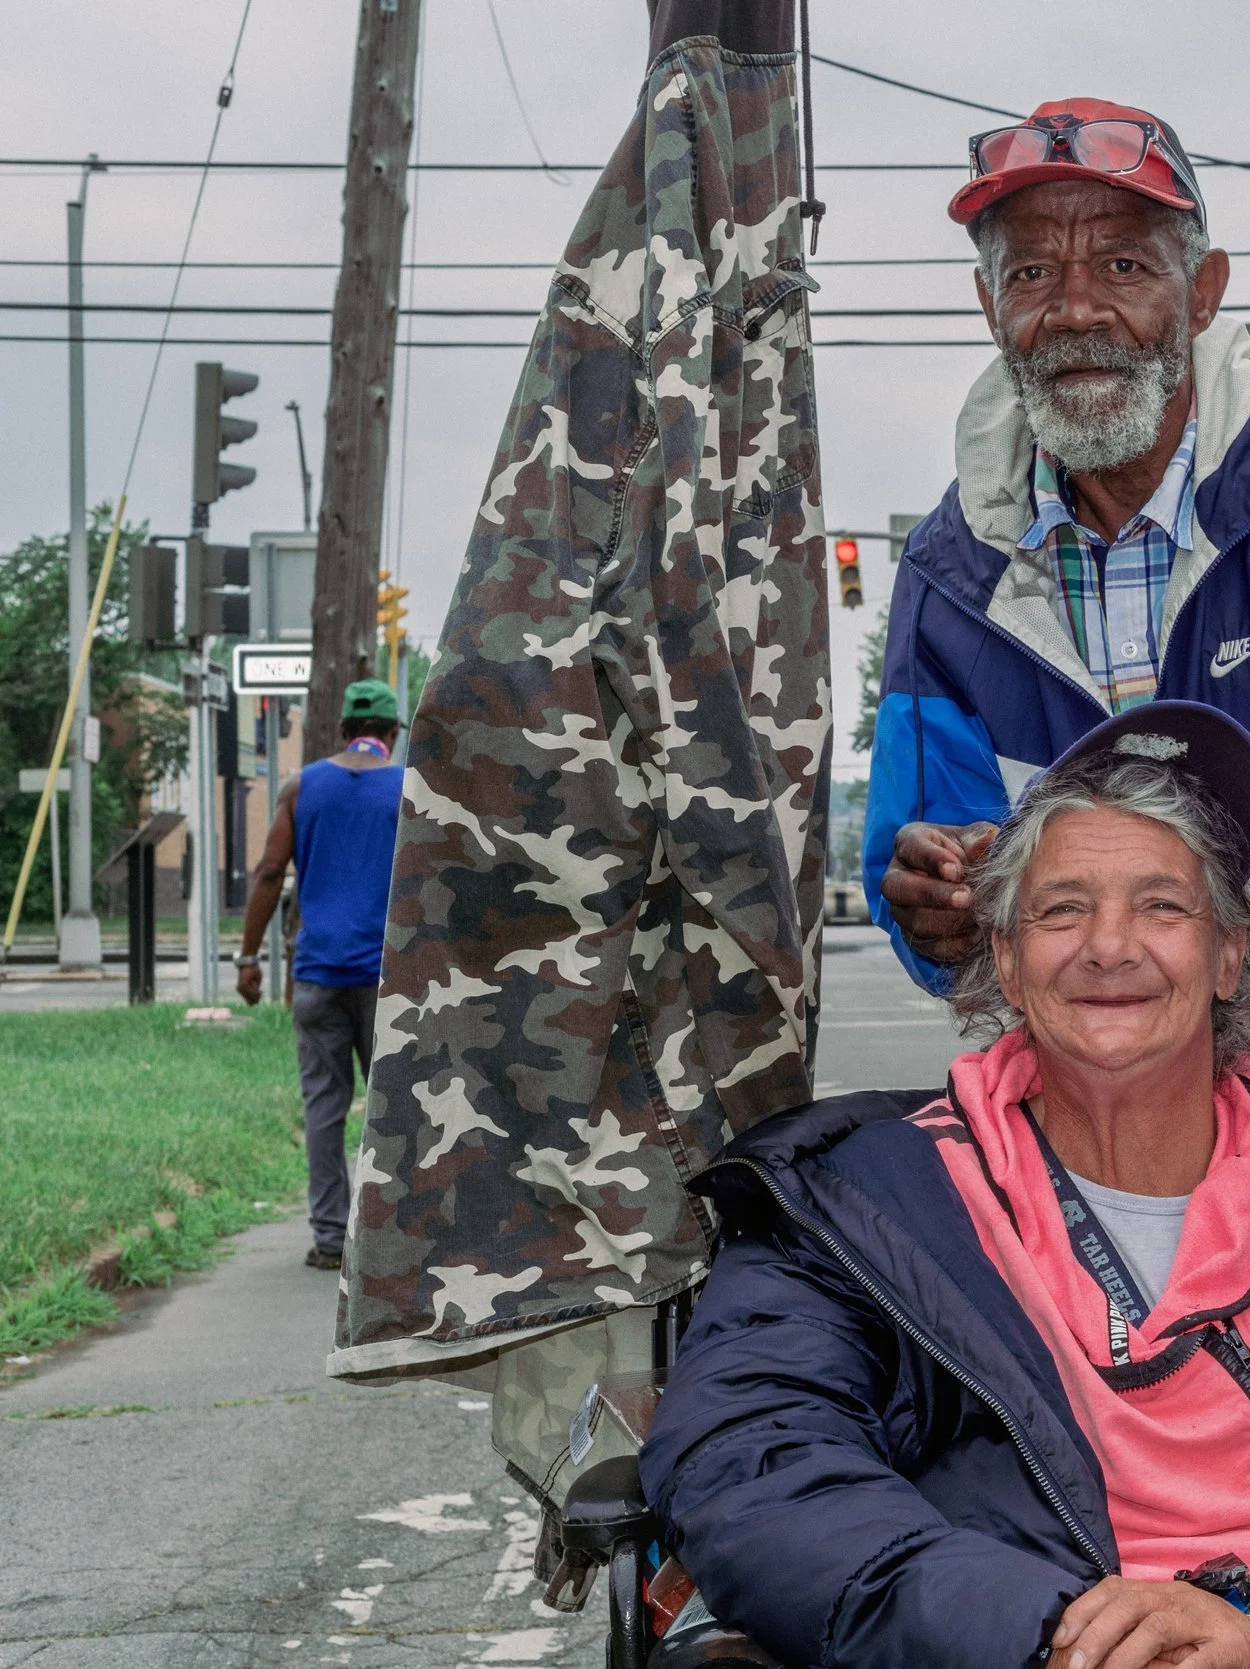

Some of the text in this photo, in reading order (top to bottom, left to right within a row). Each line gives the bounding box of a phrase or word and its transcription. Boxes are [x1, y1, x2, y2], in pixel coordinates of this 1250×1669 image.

[1216, 636, 1250, 663] NIKE
[252, 662, 285, 677] ONE
[1079, 1232, 1110, 1270] TAR
[1098, 1265, 1142, 1322] HEELS
[1110, 1318, 1129, 1350] PINK
